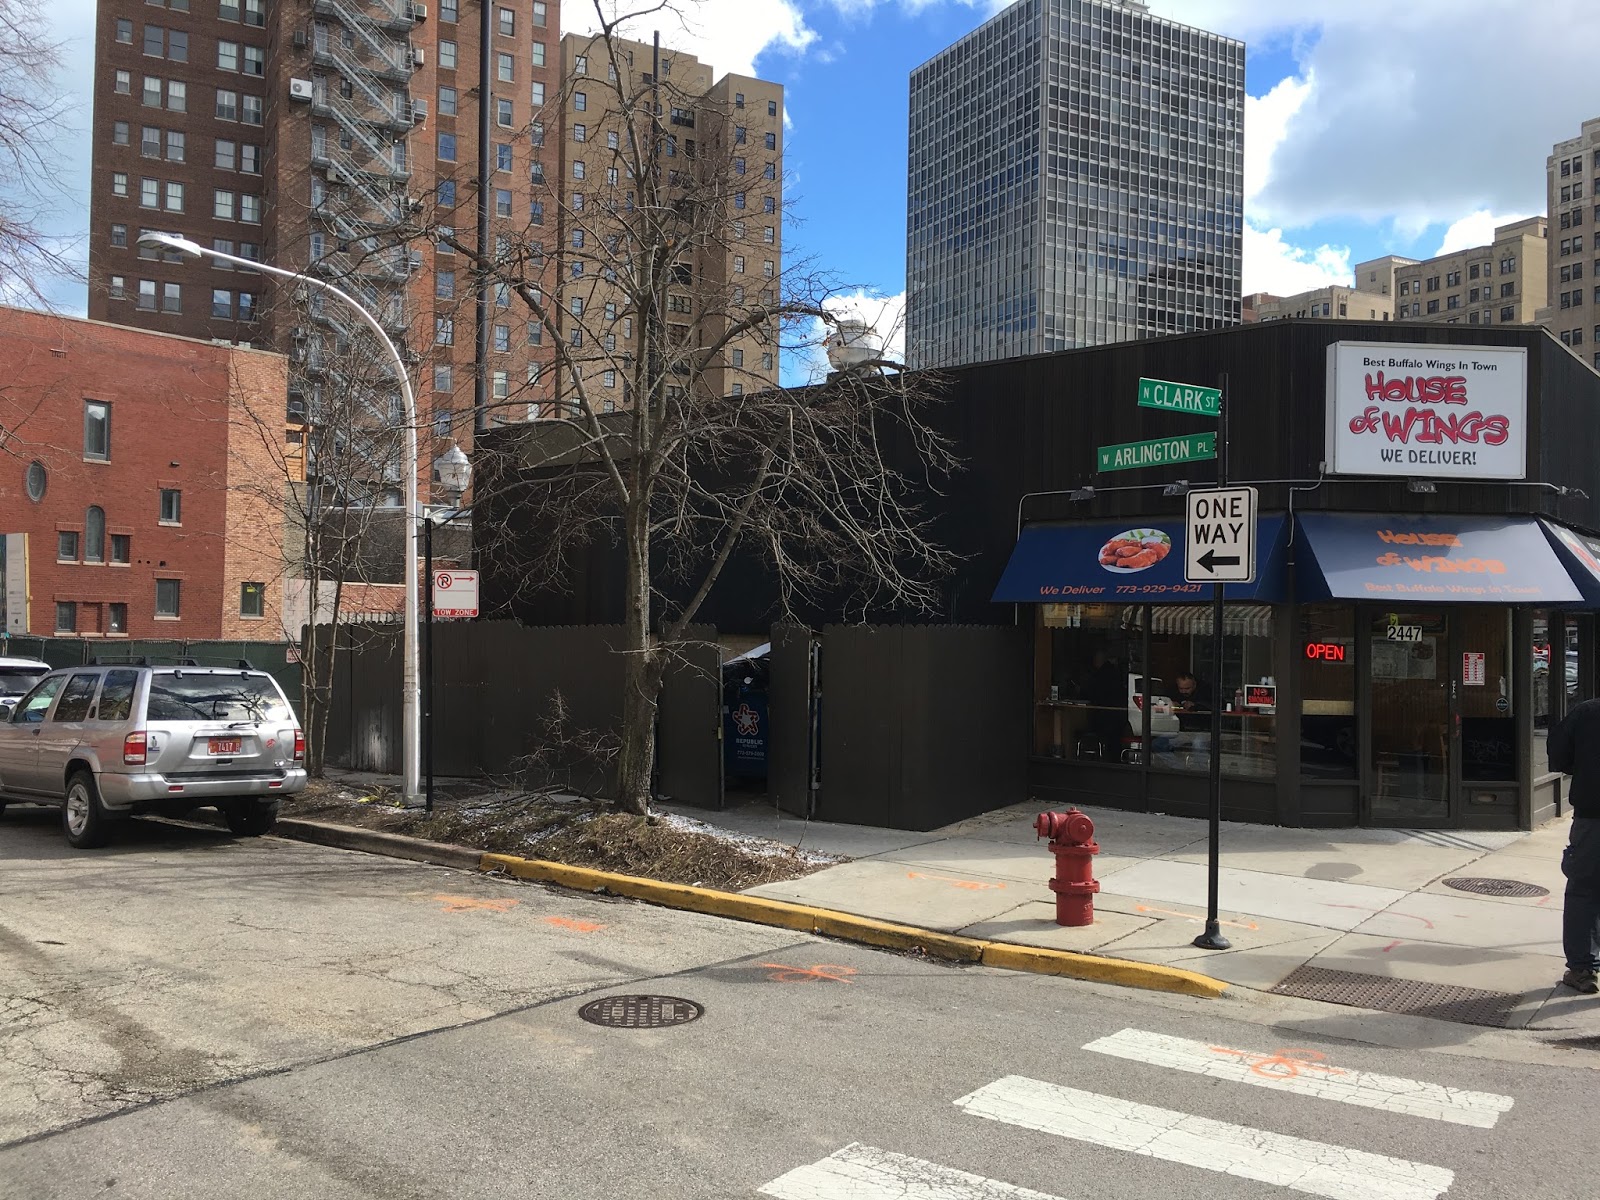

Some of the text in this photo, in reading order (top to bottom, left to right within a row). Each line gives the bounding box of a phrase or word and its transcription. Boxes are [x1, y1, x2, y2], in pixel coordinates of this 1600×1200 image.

[1363, 357, 1498, 371] Best Buffalo Wings In Town
[1143, 384, 1216, 411] N CLARK ST
[1365, 370, 1468, 406] HOUSE
[1349, 406, 1510, 446] of WINGS
[1102, 440, 1209, 467] W ARLINGTON PL
[1380, 448, 1477, 466] WE DELIVER!
[1195, 497, 1243, 519] ONE
[1194, 522, 1244, 545] WAY
[1039, 583, 1203, 595] We Deliver 773-929-9421
[1388, 626, 1422, 641] 2447
[1306, 643, 1344, 661] OPEN
[1248, 695, 1273, 704] SMOKING
